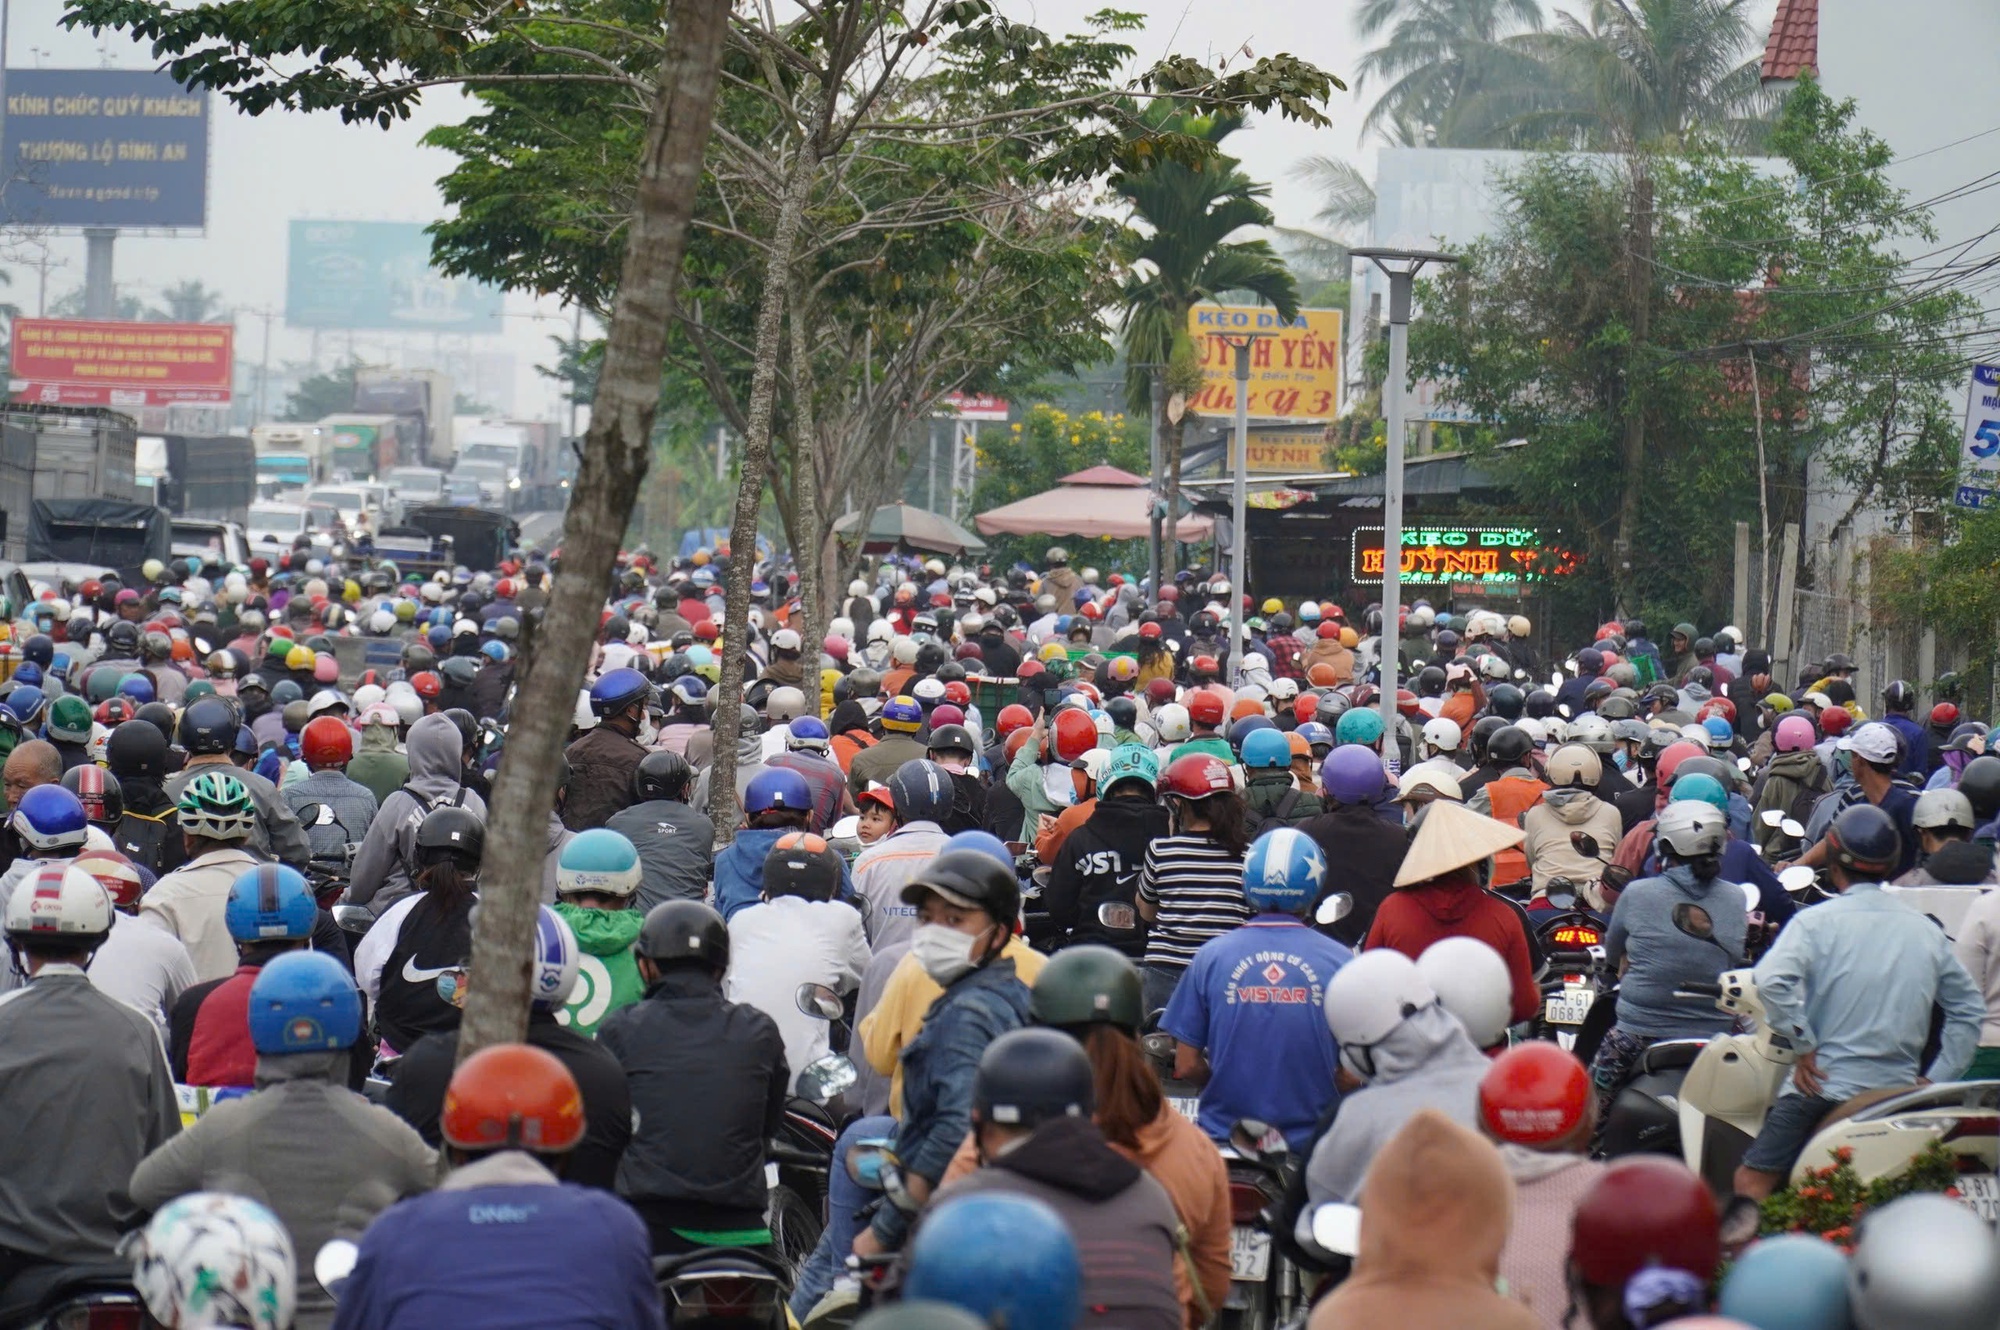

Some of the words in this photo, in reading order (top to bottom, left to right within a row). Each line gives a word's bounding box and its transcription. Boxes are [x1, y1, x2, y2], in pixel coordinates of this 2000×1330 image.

[8, 92, 48, 116] KÍNH
[53, 91, 100, 116] CHÚC
[103, 92, 139, 117] QUÝ
[143, 94, 201, 117] KHÁCH
[92, 138, 114, 166] LỘ
[162, 142, 188, 161] AN
[1281, 330, 1336, 369] YẾN
[1306, 389, 1333, 415] 3
[1247, 447, 1310, 463] UỲNH
[1255, 950, 1285, 963] ĐỘNG
[1299, 962, 1318, 983] CAO
[1236, 985, 1307, 1004] VISTAR
